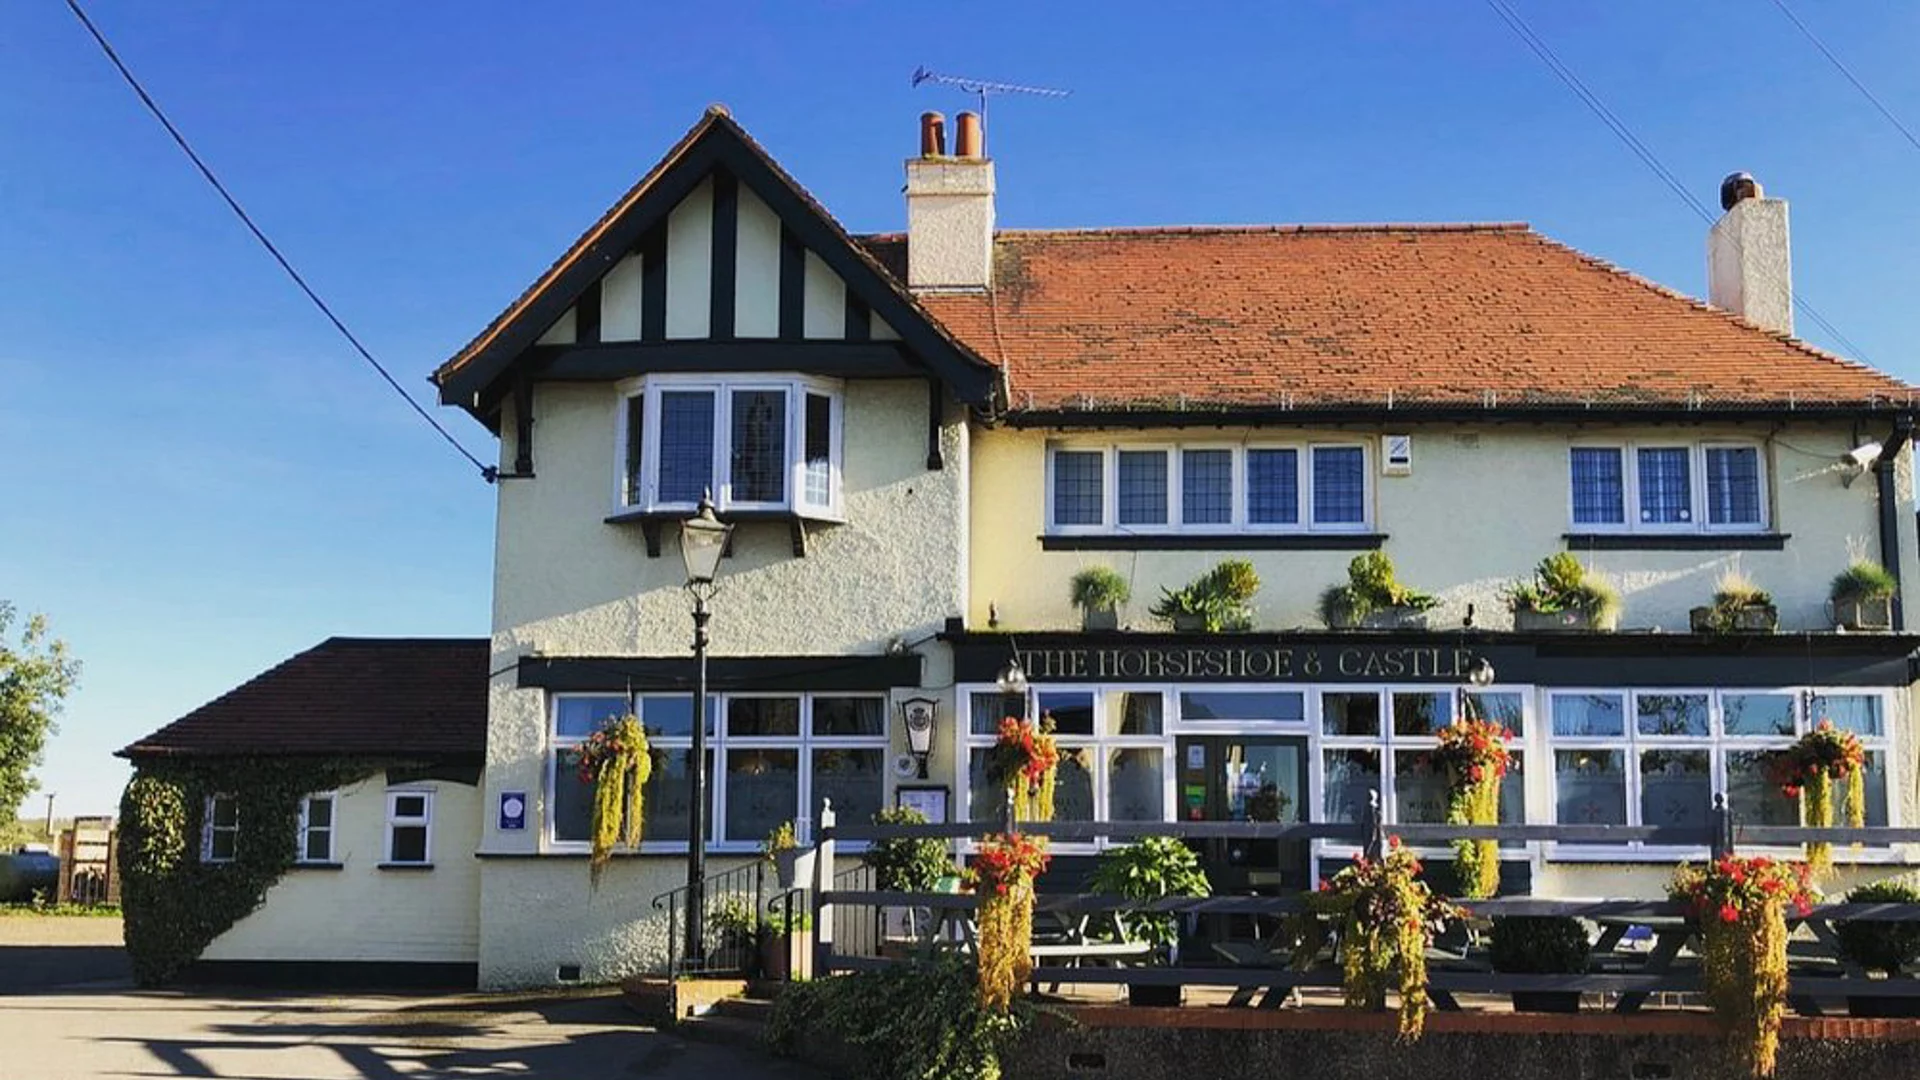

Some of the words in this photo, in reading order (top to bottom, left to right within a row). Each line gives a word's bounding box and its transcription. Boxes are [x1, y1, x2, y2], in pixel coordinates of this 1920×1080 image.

[1020, 650, 1088, 676] THE
[1097, 650, 1293, 676] HORSESHOE
[1303, 650, 1322, 676] &
[1339, 649, 1472, 676] CASTLE
